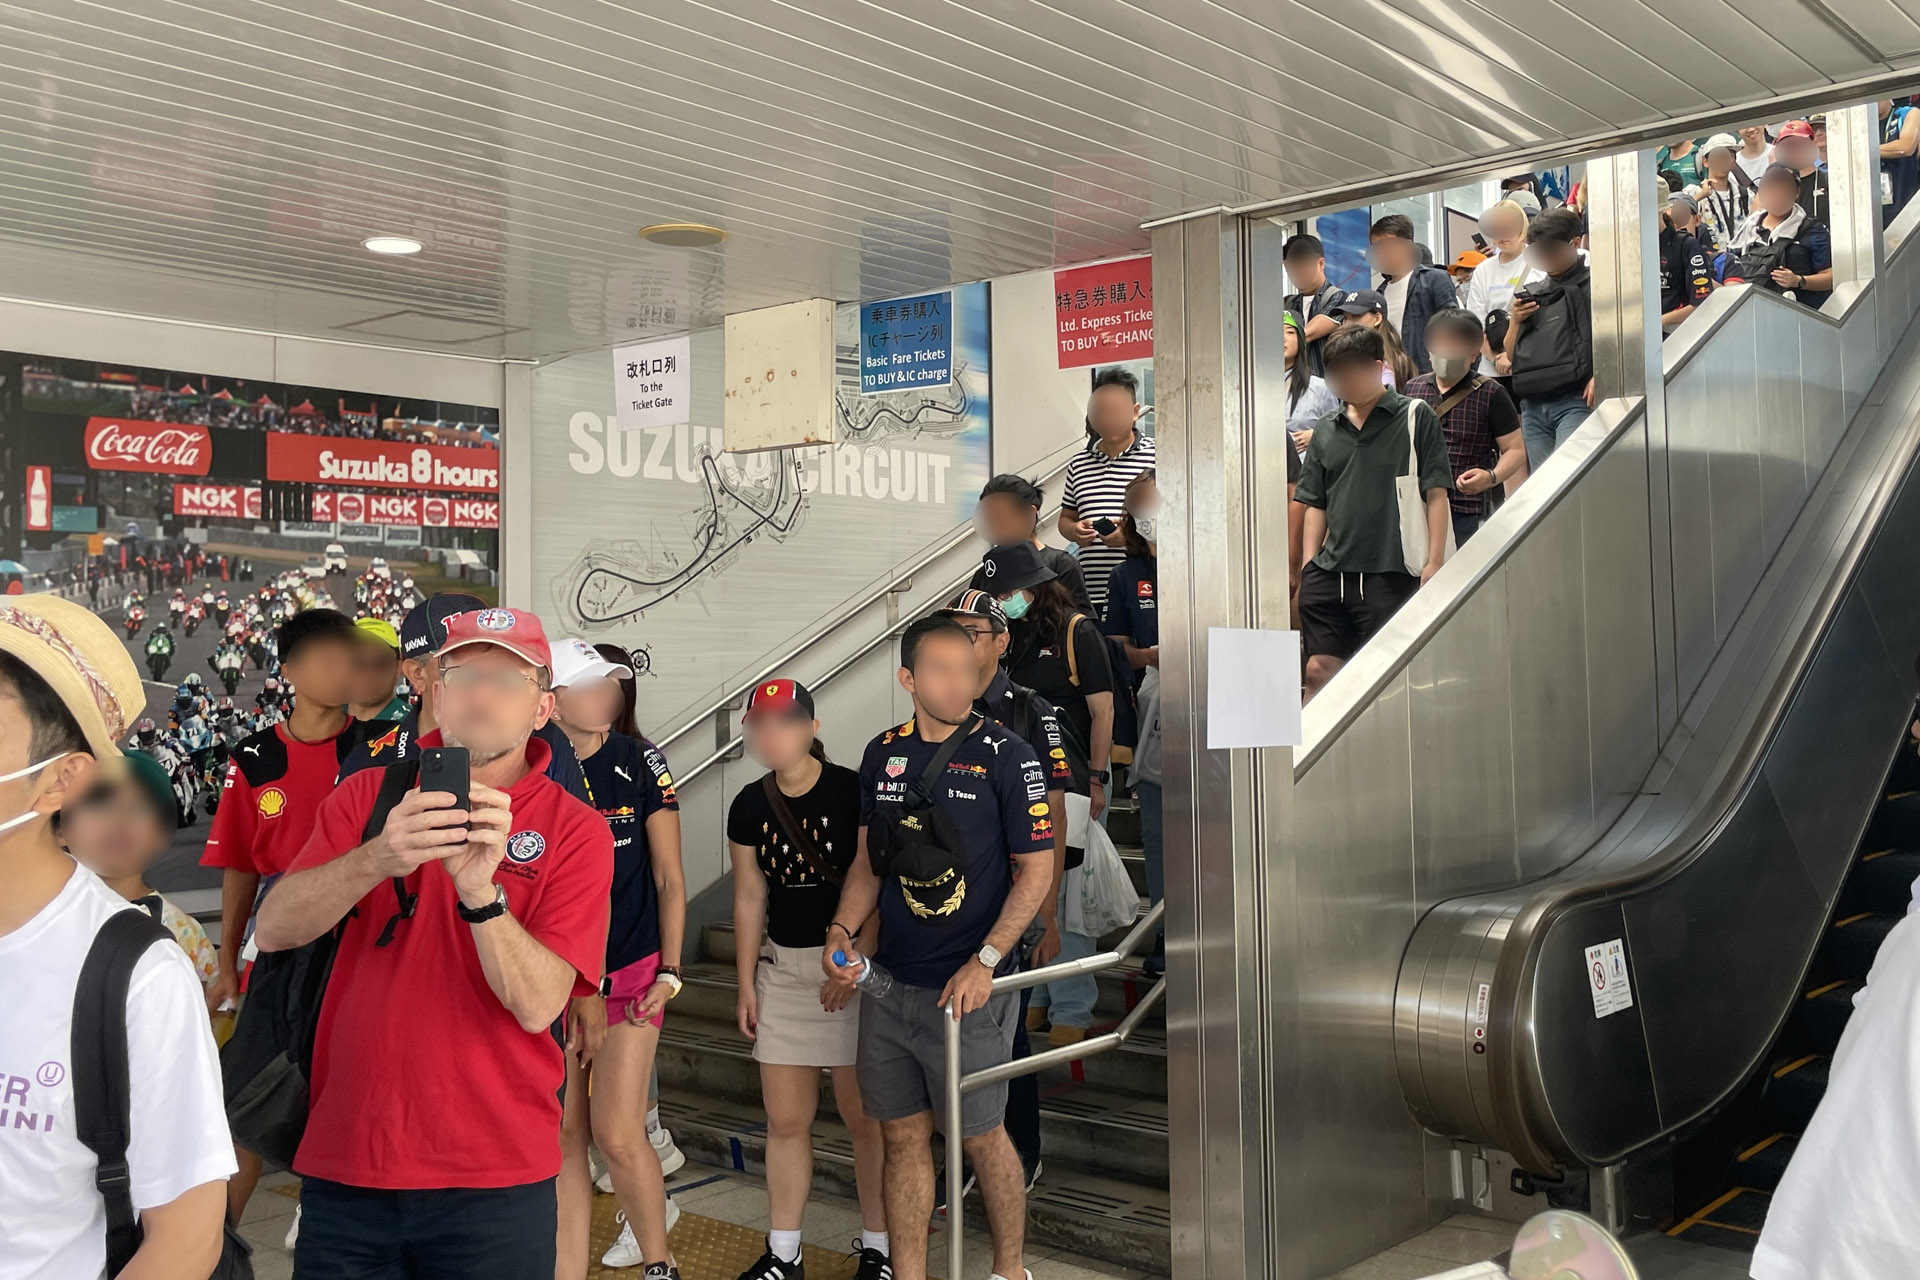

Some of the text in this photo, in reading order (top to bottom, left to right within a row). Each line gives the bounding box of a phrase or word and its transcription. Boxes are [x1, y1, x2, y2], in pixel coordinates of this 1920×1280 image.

[1056, 279, 1152, 313] 特急券購入
[871, 300, 941, 325] 乗車券購入
[1060, 318, 1079, 333] Ltd.
[1081, 314, 1121, 331] Express
[1061, 339, 1075, 352] TO
[1077, 335, 1099, 350] BUY
[626, 355, 676, 379] 改札口列
[866, 348, 946, 368] Basic Fare Tickets
[640, 381, 663, 393] To the
[864, 374, 876, 387] TO
[917, 367, 948, 381] charge
[632, 397, 673, 411] Ticket Gate
[90, 424, 206, 467] Coca-Cola
[319, 448, 498, 488] Suzuka 8 hours
[790, 441, 951, 504] CIRCUIT
[181, 486, 237, 509] NGK
[312, 493, 331, 513] K
[370, 497, 418, 518] NGK
[454, 502, 498, 521] NGK
[405, 635, 429, 652] KAYAK
[397, 731, 409, 758] zoom
[889, 758, 906, 766] TAG
[876, 794, 904, 802] ORACLE
[955, 790, 976, 800] Tezos
